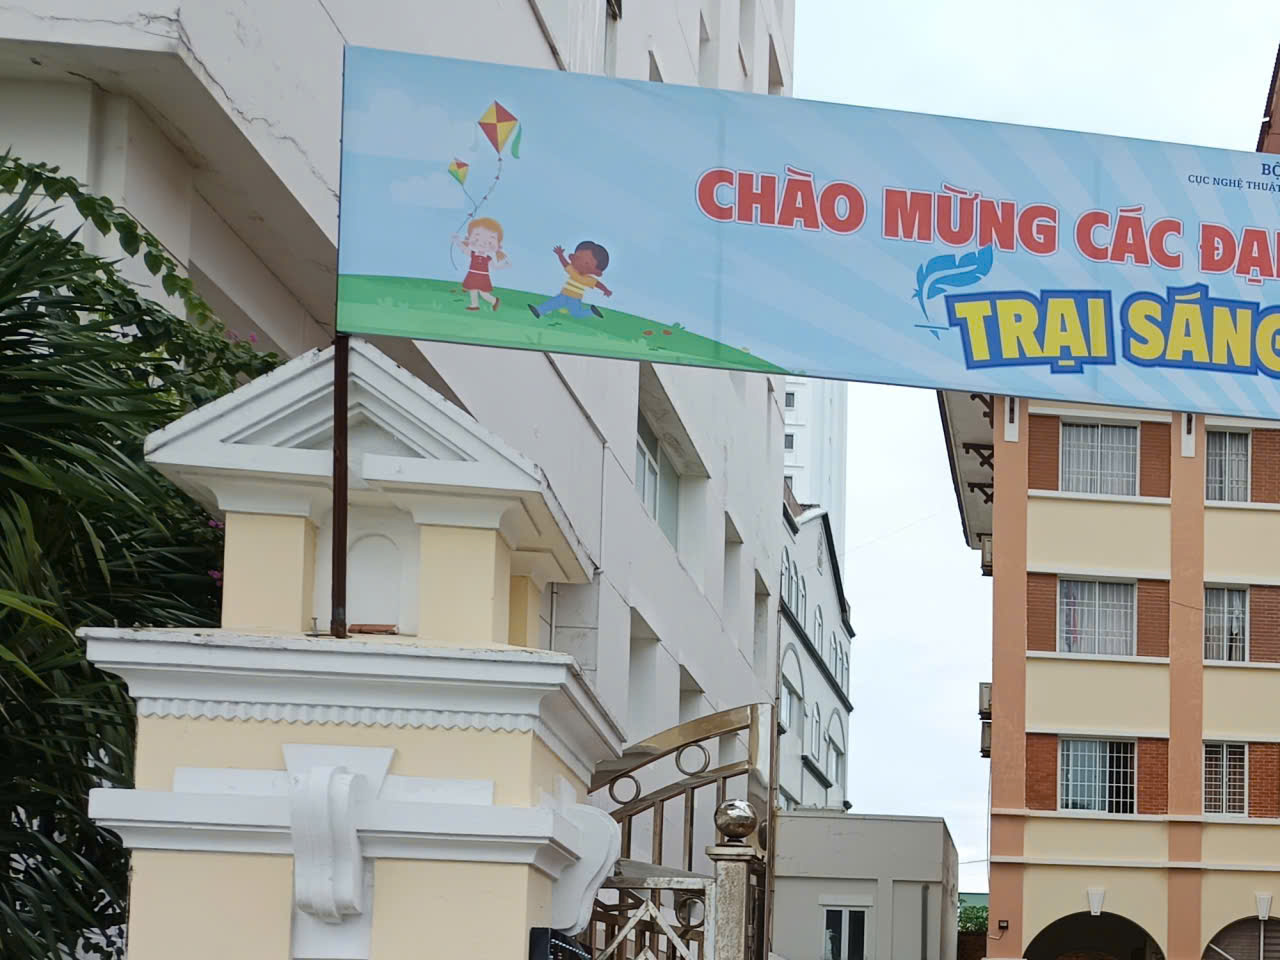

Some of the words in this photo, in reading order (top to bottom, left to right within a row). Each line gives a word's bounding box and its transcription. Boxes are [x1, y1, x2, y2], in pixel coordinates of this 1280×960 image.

[697, 166, 865, 233] CHÀO
[882, 184, 1058, 255] MỪNG
[1075, 205, 1182, 269] CÁC
[950, 294, 1112, 370] TRẠI
